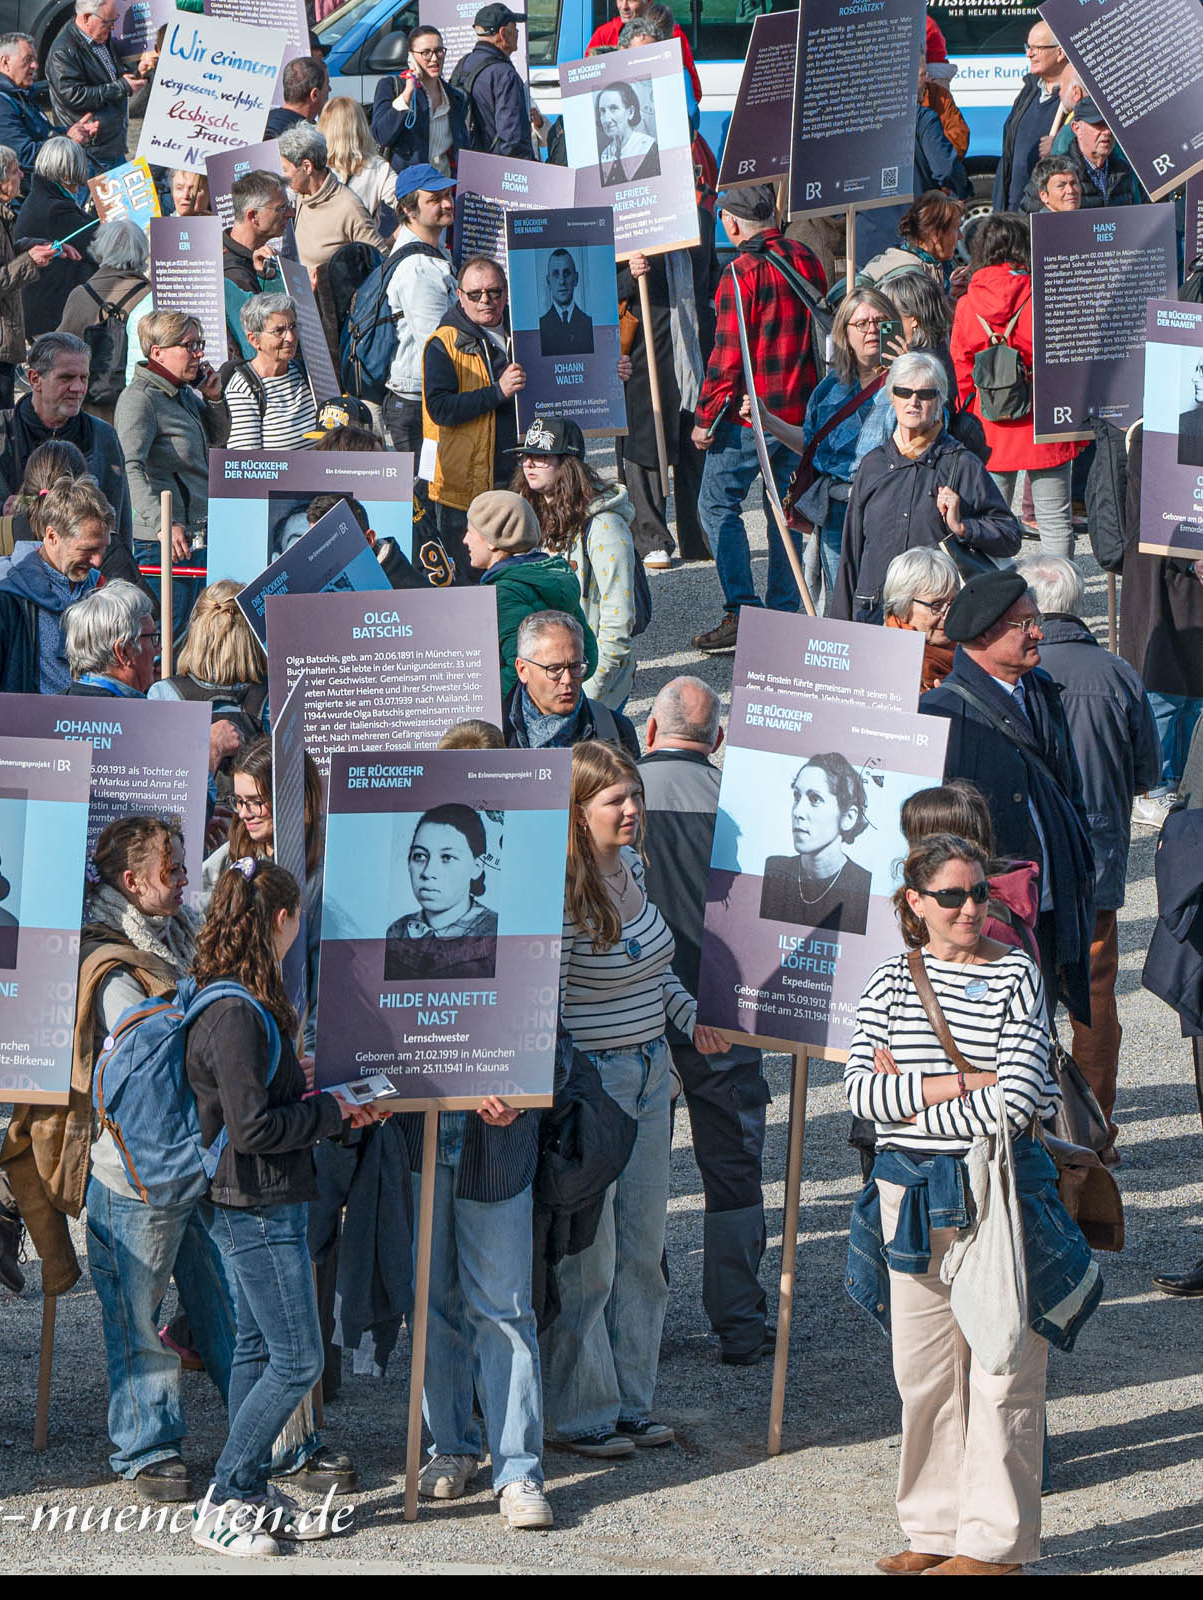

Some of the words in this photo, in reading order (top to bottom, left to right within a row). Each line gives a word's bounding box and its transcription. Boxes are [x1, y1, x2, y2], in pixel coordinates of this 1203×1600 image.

[948, 8, 963, 16] WIR
[968, 8, 996, 16] HELFEN
[169, 23, 207, 63] Wir
[211, 50, 278, 78] erinnern
[202, 72, 222, 83] an
[160, 78, 218, 100] vergessene,
[221, 91, 265, 111] verfolgte
[167, 100, 240, 132] lesbische
[150, 135, 161, 147] in
[162, 139, 183, 150] der
[187, 124, 248, 147] Frauen
[502, 171, 527, 184] EUGEN
[501, 180, 528, 193] FROMM
[1093, 222, 1116, 232] HANS
[1096, 232, 1113, 242] RIES
[554, 362, 584, 373] JOHANN
[555, 374, 584, 384] WALTER
[364, 611, 400, 624] OLGA
[352, 624, 413, 639] BATSCHIS
[807, 638, 849, 656] MORITZ
[285, 655, 304, 666] Olga
[306, 654, 340, 663] Batschis,
[341, 652, 358, 664] geb.
[373, 650, 414, 660] 20.06.1891
[415, 650, 423, 658] in
[424, 649, 464, 658] München,
[804, 652, 850, 671] EINSTEIN
[748, 703, 762, 714] DIE
[764, 704, 813, 723] RÜCKKEHR
[53, 719, 122, 735] JOHANNA
[746, 715, 763, 726] DER
[765, 717, 802, 732] NAMEN
[348, 766, 365, 777] DIE
[367, 764, 423, 776] RÜCKKEHR
[347, 778, 368, 788] DER
[370, 777, 411, 788] NAMEN
[779, 934, 805, 952] ILSE
[808, 940, 842, 959] JETTI
[781, 951, 837, 976] LÖFFLER
[782, 976, 832, 992] Expedientin
[379, 992, 423, 1008] HILDE
[427, 991, 497, 1007] NANETTE
[734, 984, 769, 999] Geboren
[772, 992, 785, 1001] am
[788, 993, 826, 1009] 15.09.1912
[828, 1001, 836, 1010] in
[417, 1010, 458, 1025] NAST
[738, 998, 776, 1013] Ermordet
[778, 1007, 791, 1016] am
[794, 1008, 830, 1022] 25.11.1941
[832, 1015, 840, 1024] in
[403, 1032, 469, 1043] Lernschwester
[355, 1050, 394, 1061] Geboren
[397, 1052, 412, 1060] am
[414, 1049, 458, 1060] 21.02.1919
[460, 1048, 469, 1058] in
[471, 1047, 515, 1058] München
[359, 1064, 402, 1076] Ermordet
[404, 1065, 420, 1073] am
[422, 1062, 462, 1073] 25.11.1941
[465, 1062, 473, 1072] in
[476, 1062, 509, 1072] Kaunas
